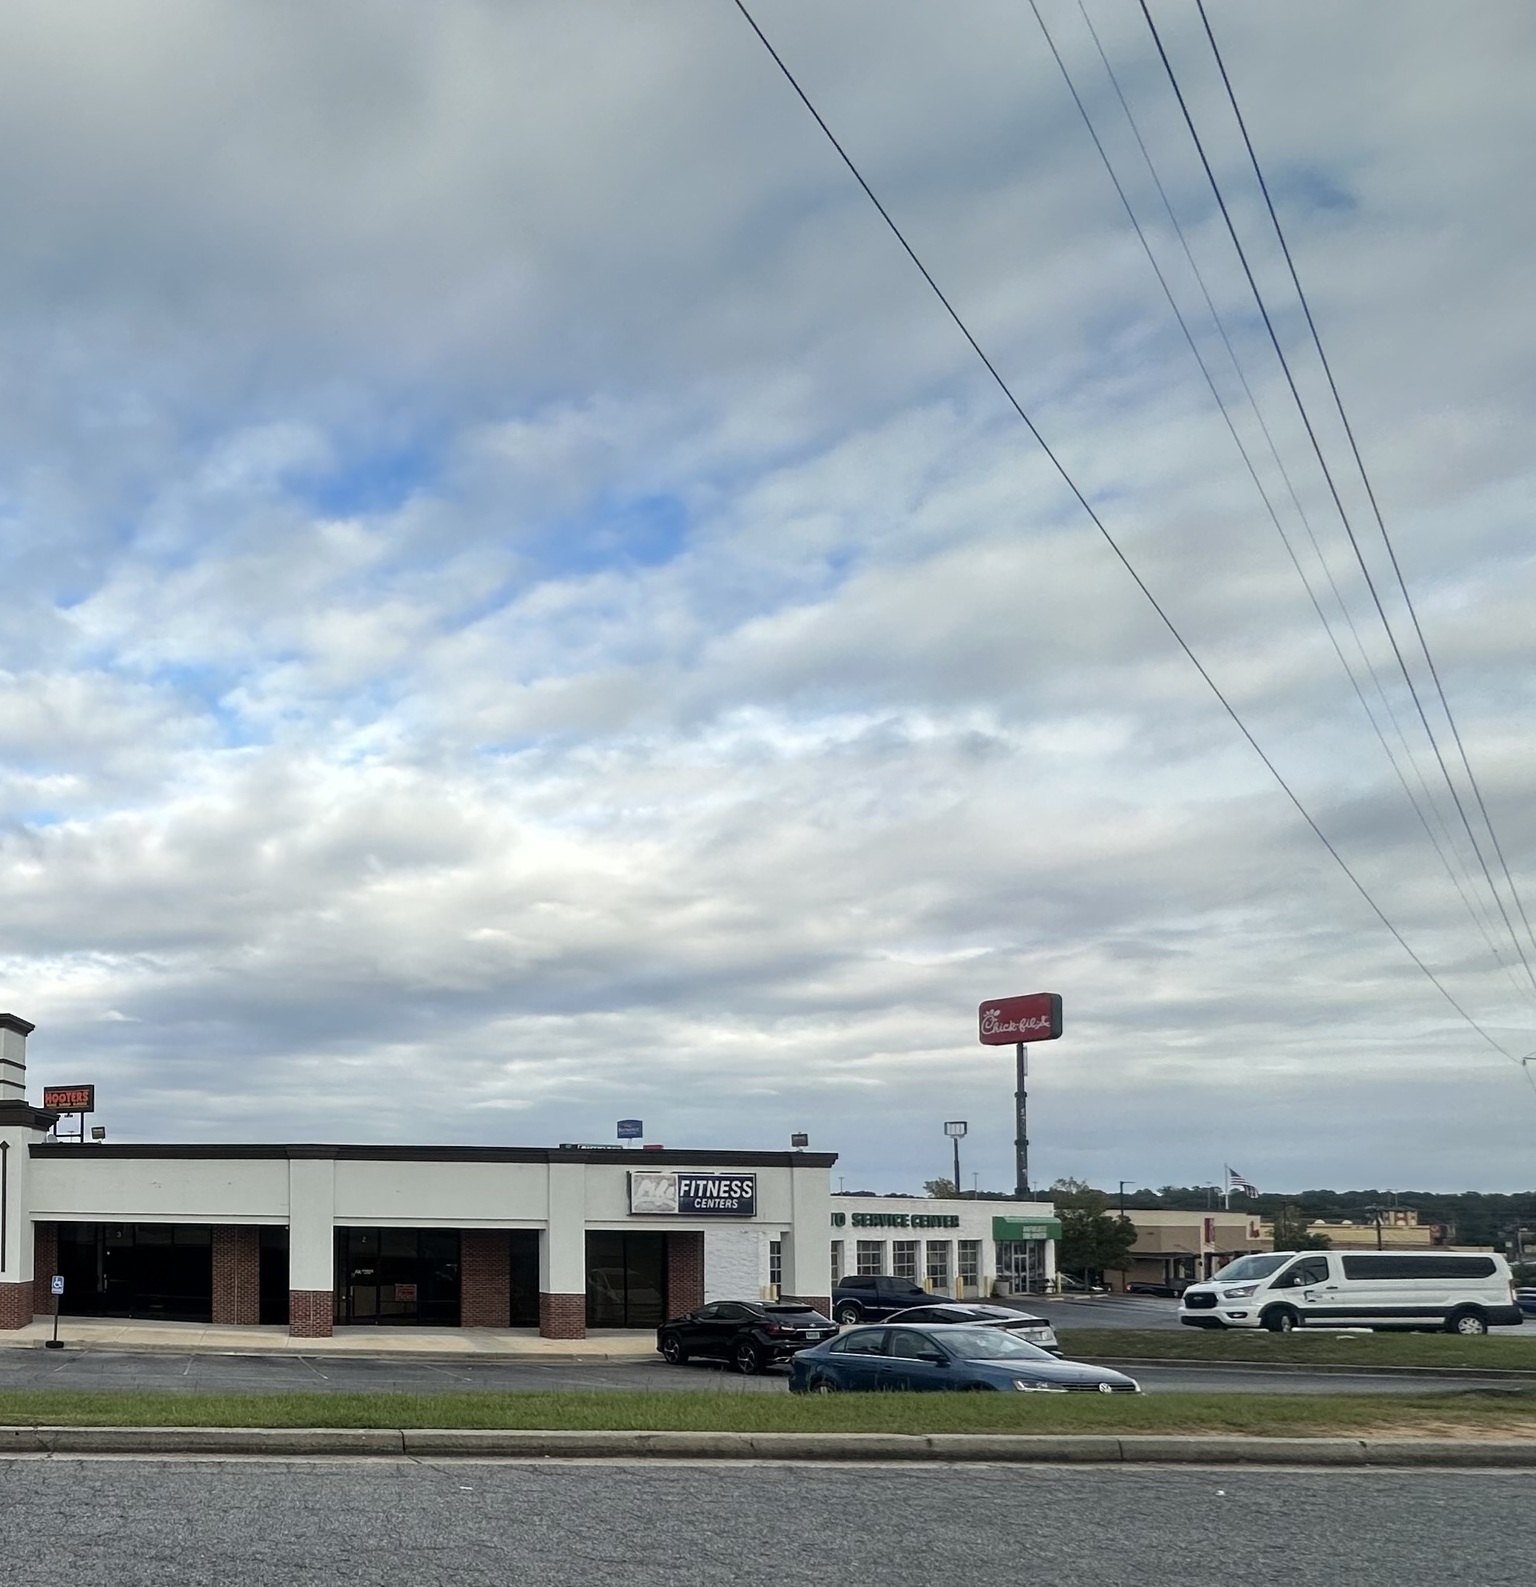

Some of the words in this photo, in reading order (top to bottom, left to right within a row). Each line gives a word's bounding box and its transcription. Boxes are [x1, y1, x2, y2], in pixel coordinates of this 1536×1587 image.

[981, 1014, 1052, 1035] Chick-fil-A
[45, 1091, 89, 1104] HOOTERS
[679, 1180, 753, 1198] FITNESS
[694, 1198, 739, 1209] CENTERS
[851, 1213, 910, 1227] SERVICE
[911, 1214, 960, 1228] CENTER
